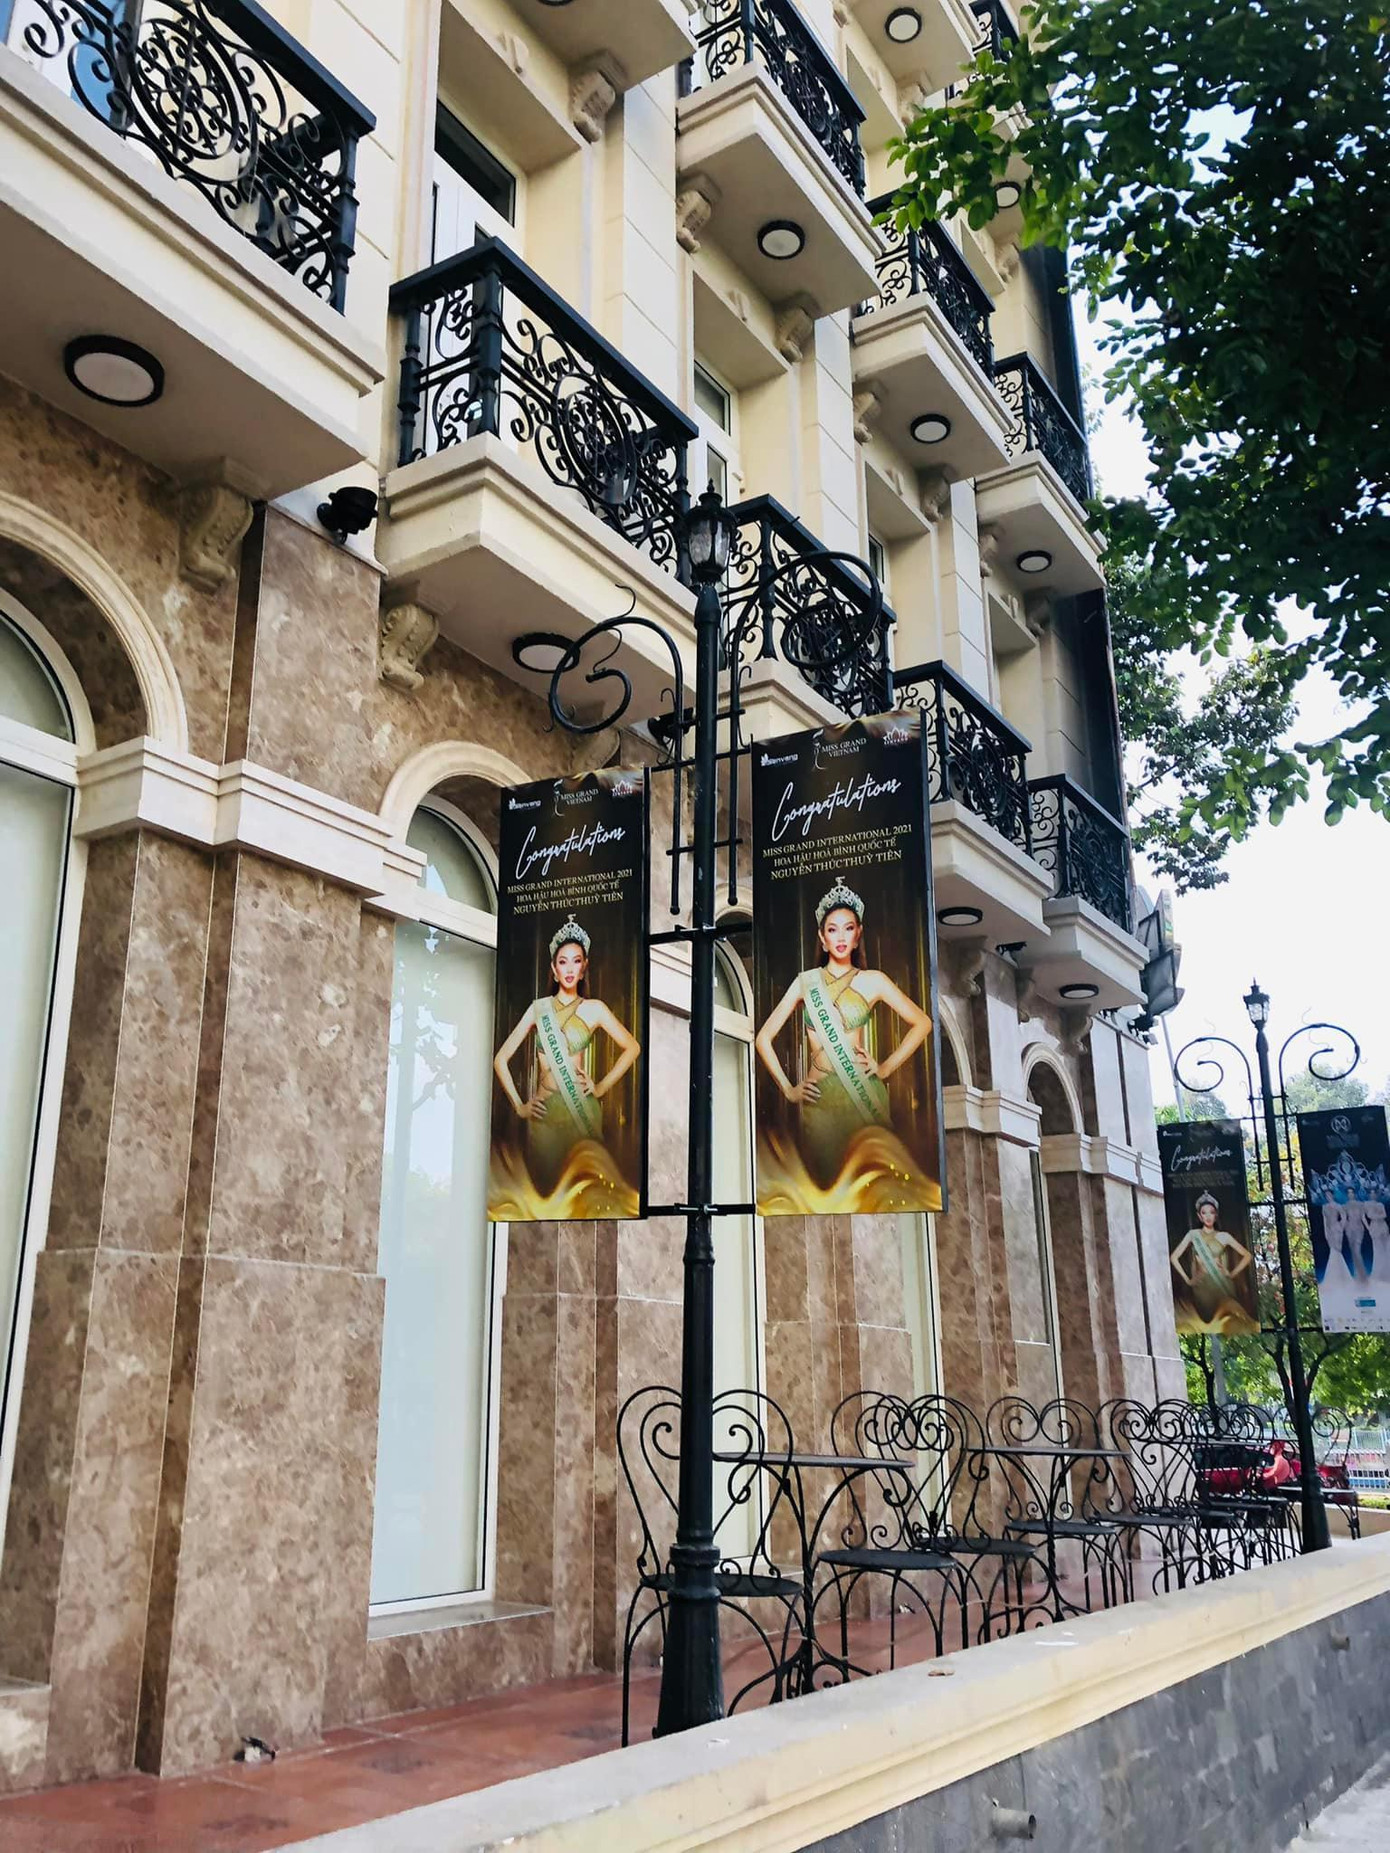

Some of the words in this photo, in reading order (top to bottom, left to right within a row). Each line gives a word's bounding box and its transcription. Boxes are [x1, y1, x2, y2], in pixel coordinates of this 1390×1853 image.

[828, 746, 860, 758] VIETNAM
[839, 737, 867, 748] GRAND
[771, 772, 902, 842] Congratulations
[515, 821, 626, 880] Congratulations
[762, 845, 783, 858] MISS
[783, 840, 815, 853] GRAND
[816, 828, 892, 847] INTERNATIONAL
[893, 824, 913, 835] 2021
[774, 857, 793, 867] HOA
[875, 849, 902, 863] TIÊN
[507, 884, 525, 894] MISS
[525, 880, 553, 891] GRAND
[553, 871, 616, 887] INTERNATIONAL
[617, 868, 633, 878] 2021
[516, 894, 533, 903] HOA
[602, 891, 624, 903] TIÊN
[809, 987, 823, 1009] MISS
[817, 1008, 839, 1044] GRAND
[541, 1014, 553, 1033] MISS
[547, 1033, 564, 1066] GRAND
[559, 1065, 595, 1137] INTERNATIO
